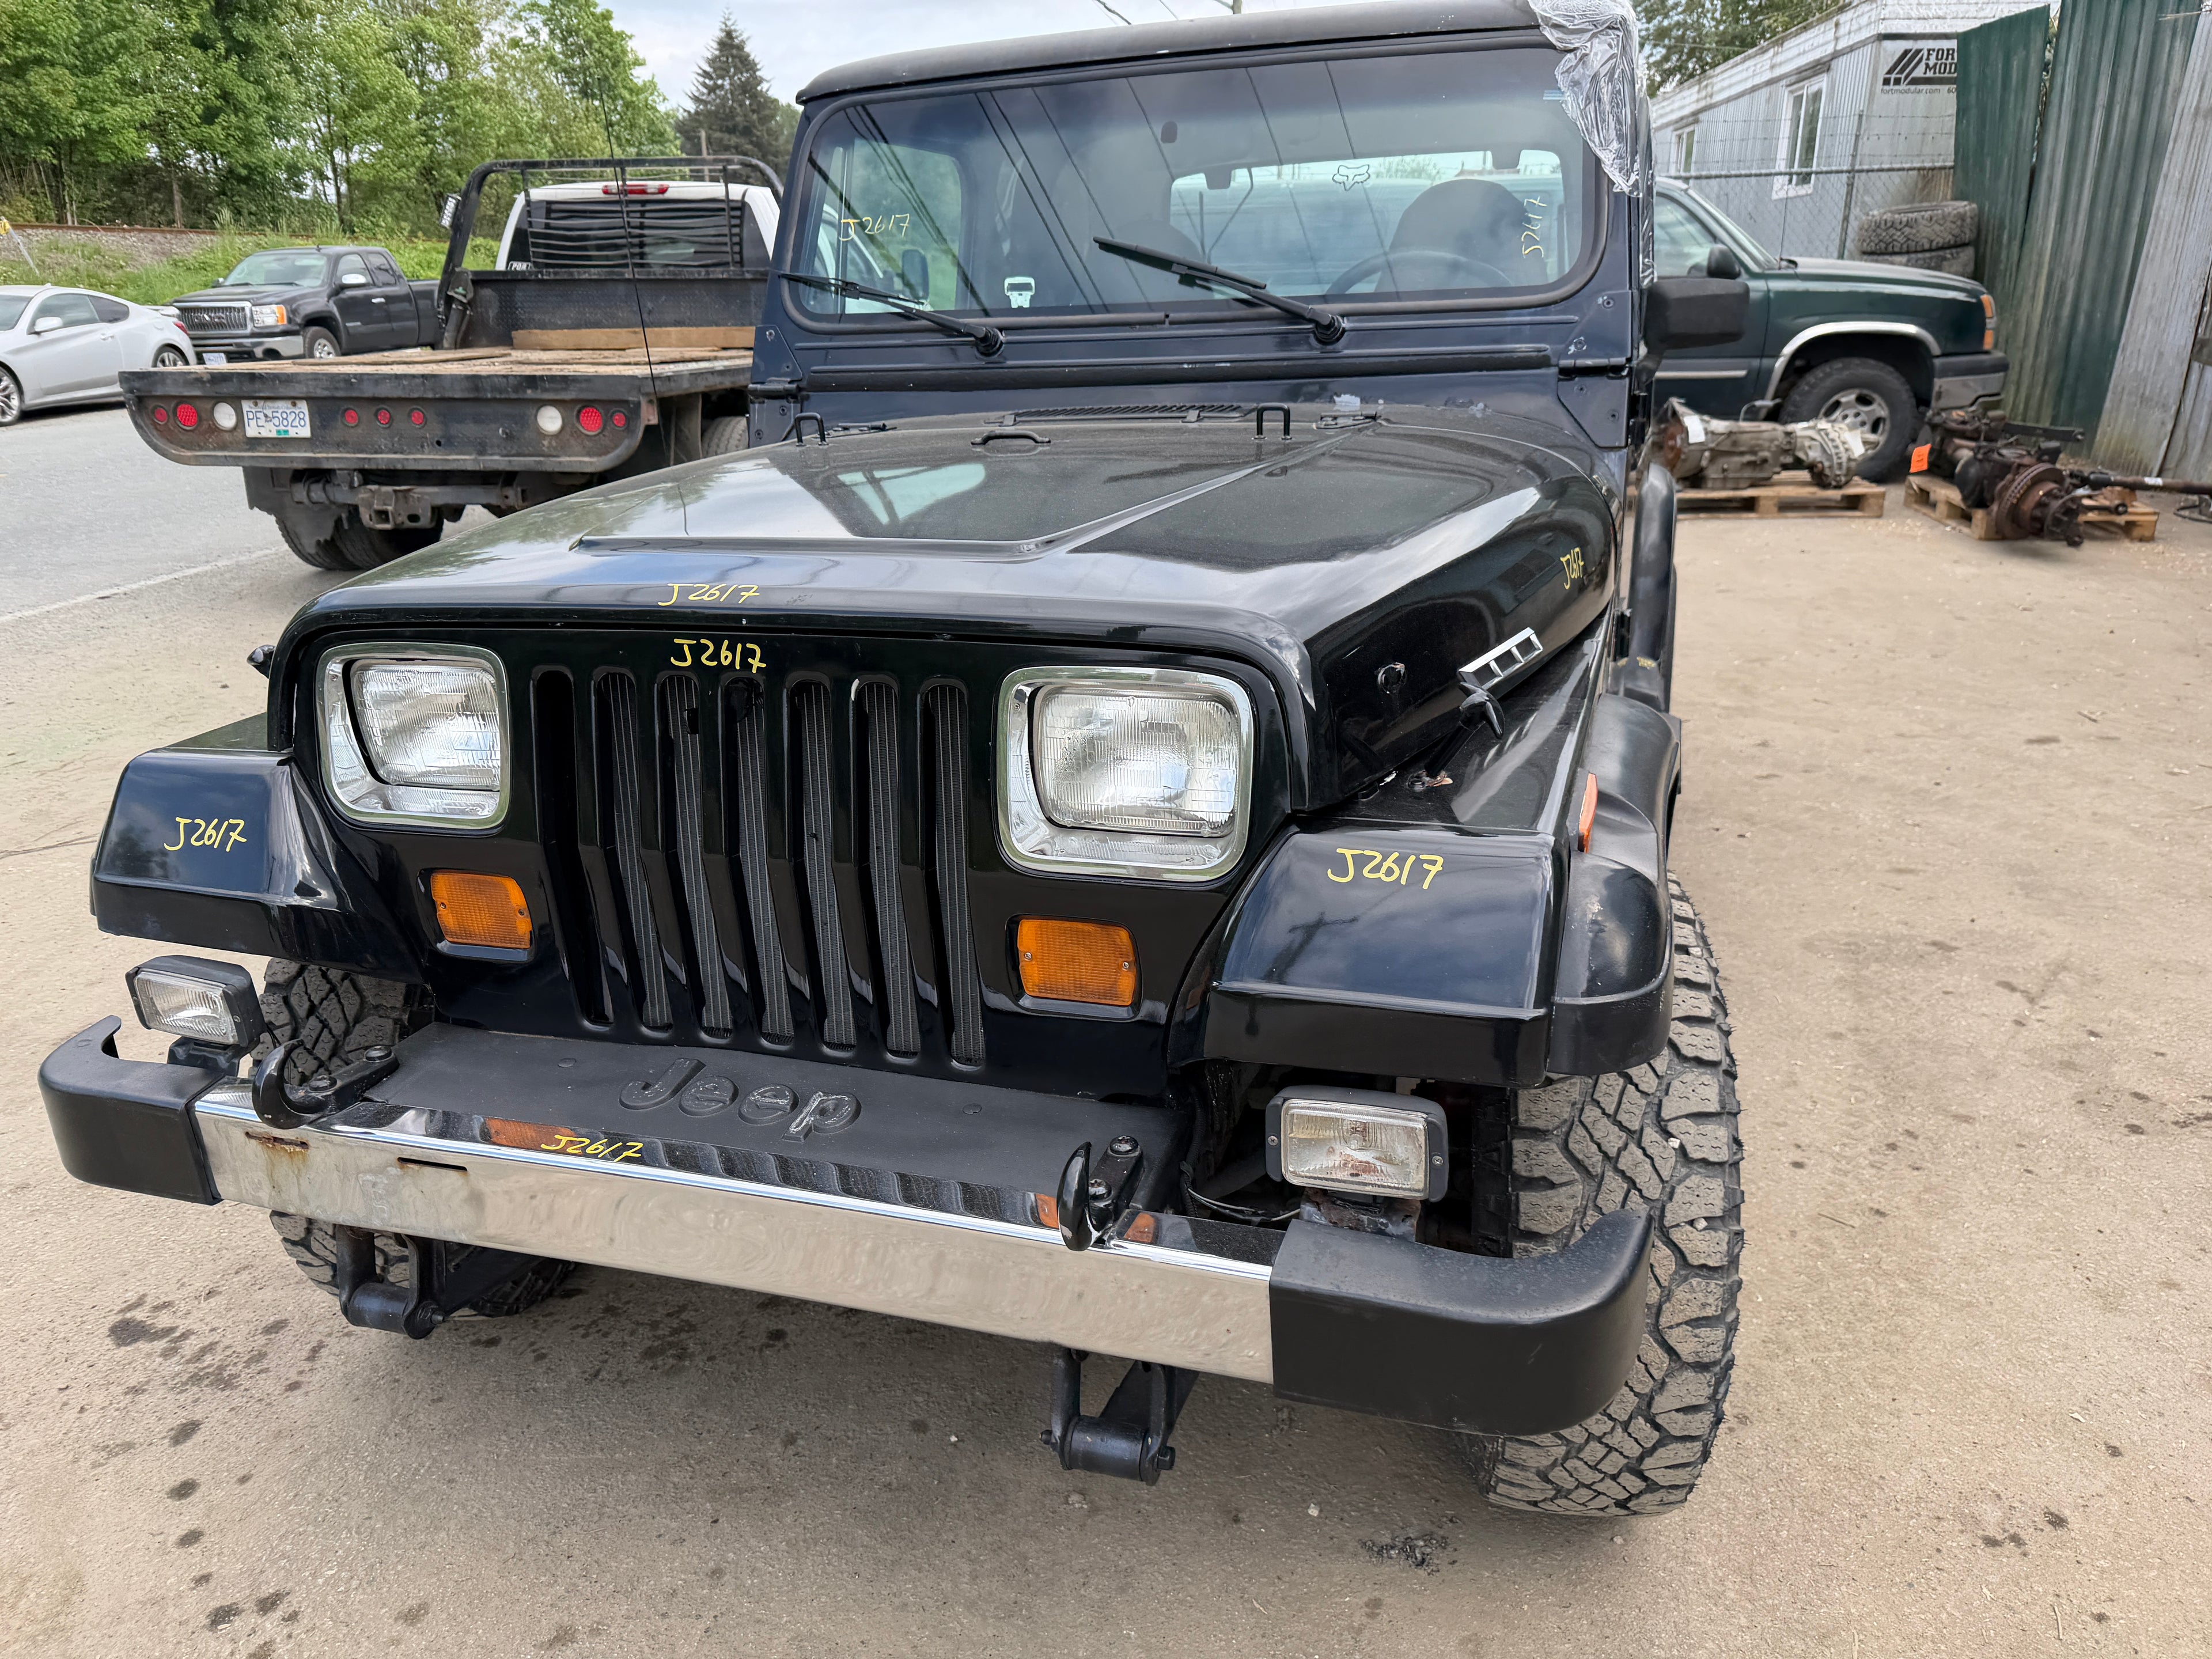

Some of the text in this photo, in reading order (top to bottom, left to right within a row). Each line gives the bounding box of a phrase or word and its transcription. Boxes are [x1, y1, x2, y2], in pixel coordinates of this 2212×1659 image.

[1923, 62, 1957, 75] MOD
[1880, 86, 1941, 94] fortmodular.com
[839, 213, 910, 241] J2617
[245, 410, 306, 428] PE 5828
[657, 583, 760, 607] J2617
[671, 638, 767, 674] J2617
[164, 816, 248, 853] J2617
[1327, 847, 1444, 890] J2617
[618, 1057, 862, 1143] Jeep
[540, 1134, 644, 1162] J2617
